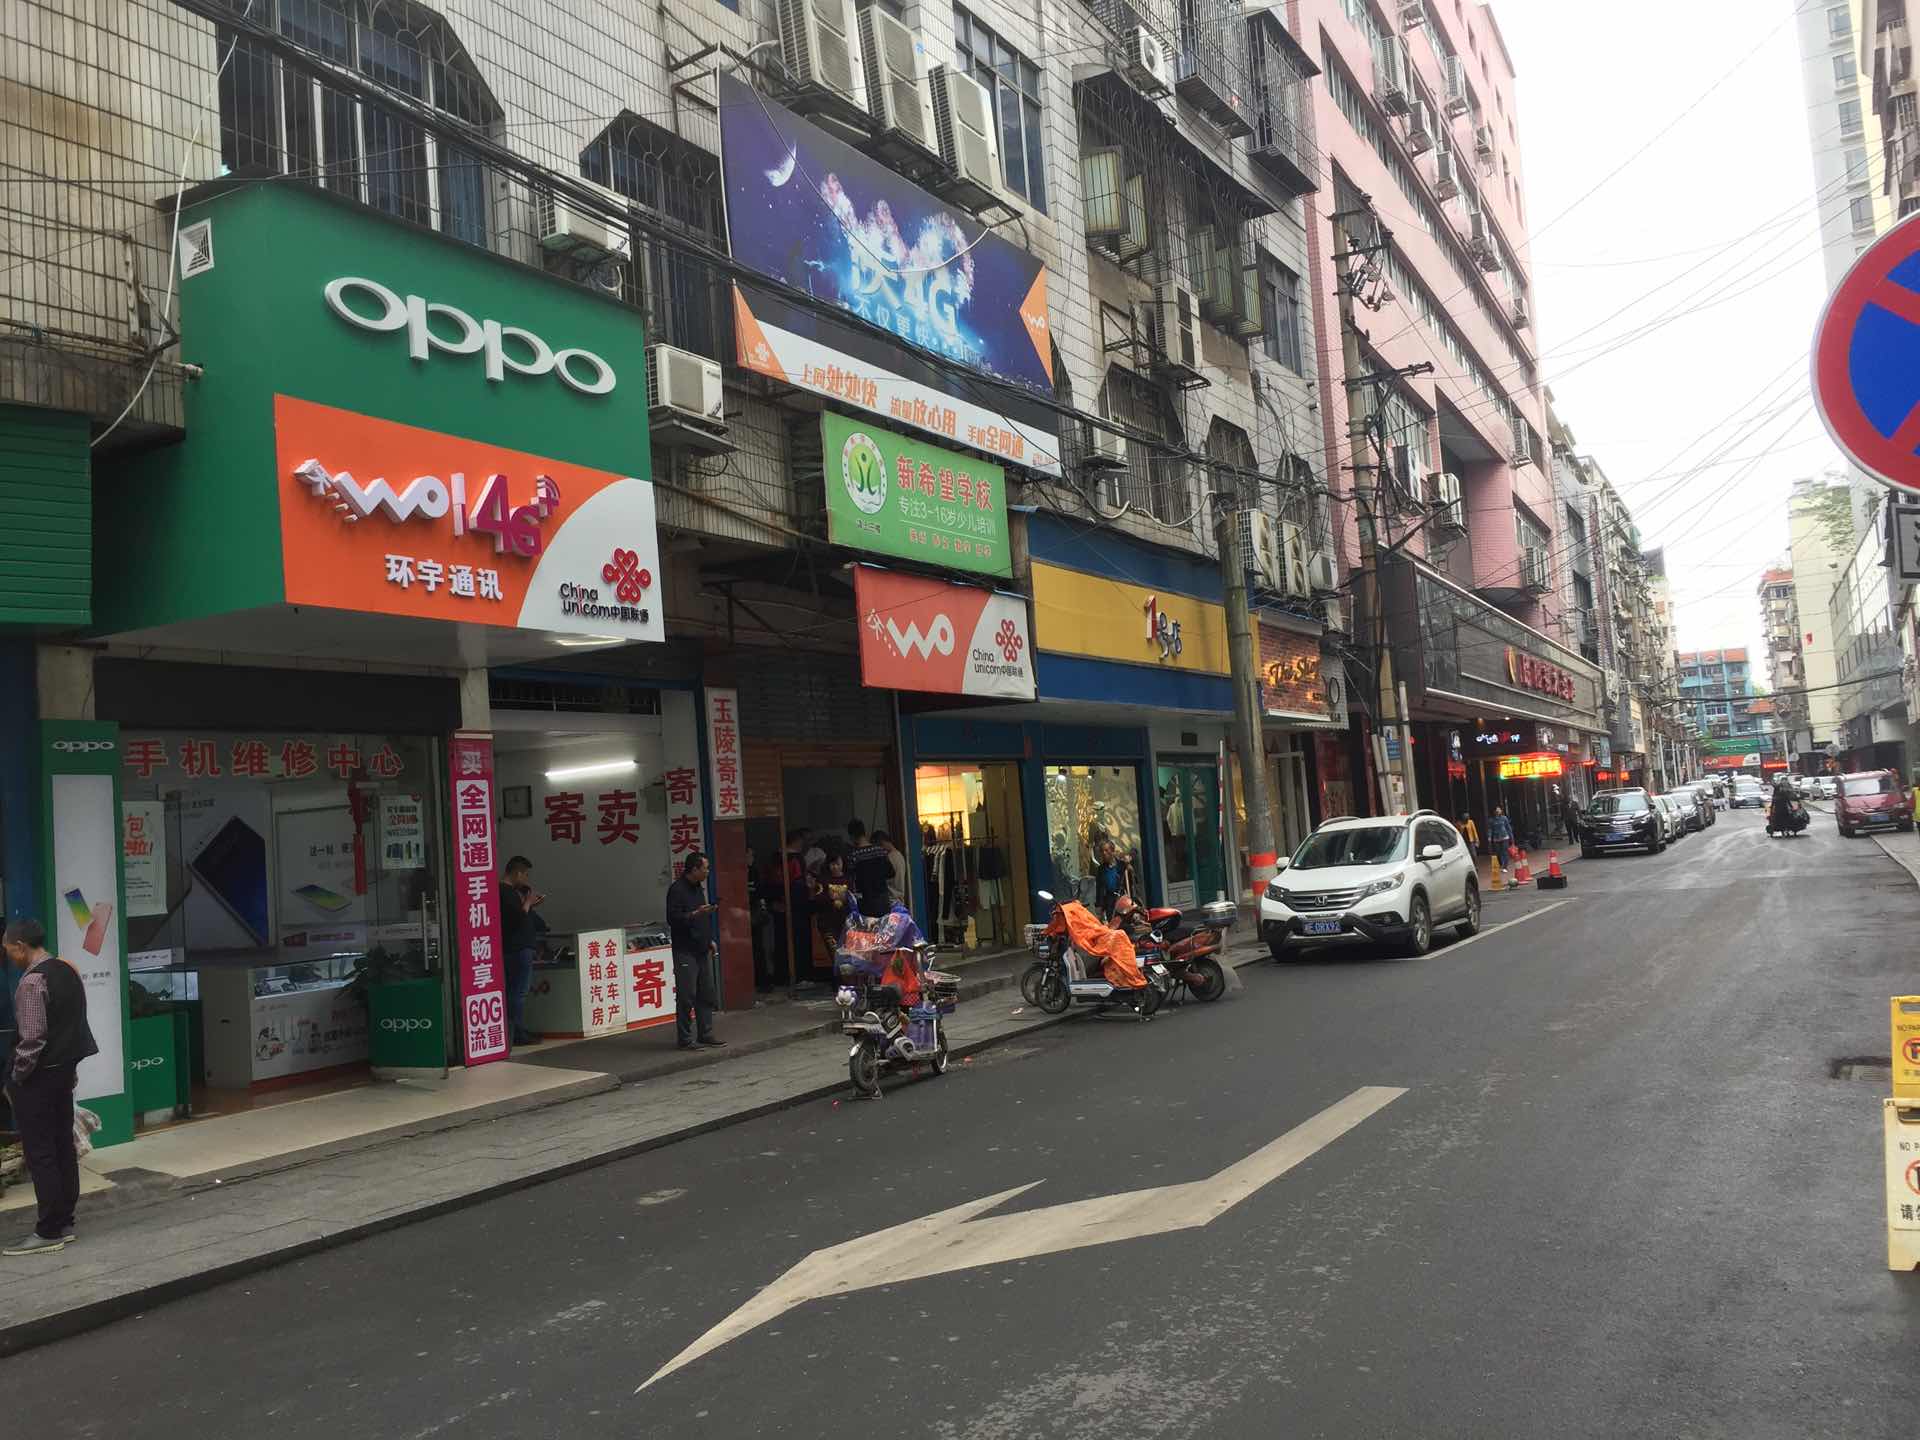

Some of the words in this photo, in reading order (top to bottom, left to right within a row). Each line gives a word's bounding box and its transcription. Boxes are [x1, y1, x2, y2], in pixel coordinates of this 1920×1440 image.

[897, 455, 993, 512] 新希望学校
[384, 552, 504, 602] 环宇通讯
[559, 582, 599, 602] China
[561, 599, 610, 618] unicom
[1144, 594, 1182, 660] 1号店
[972, 648, 995, 663] China
[124, 738, 404, 777] 手机维修中心
[713, 697, 740, 815] 玉陵寄卖
[543, 789, 641, 845] 寄卖
[664, 767, 702, 855] 寄卖
[468, 996, 502, 1027] 60G
[470, 1025, 504, 1052] 流量
